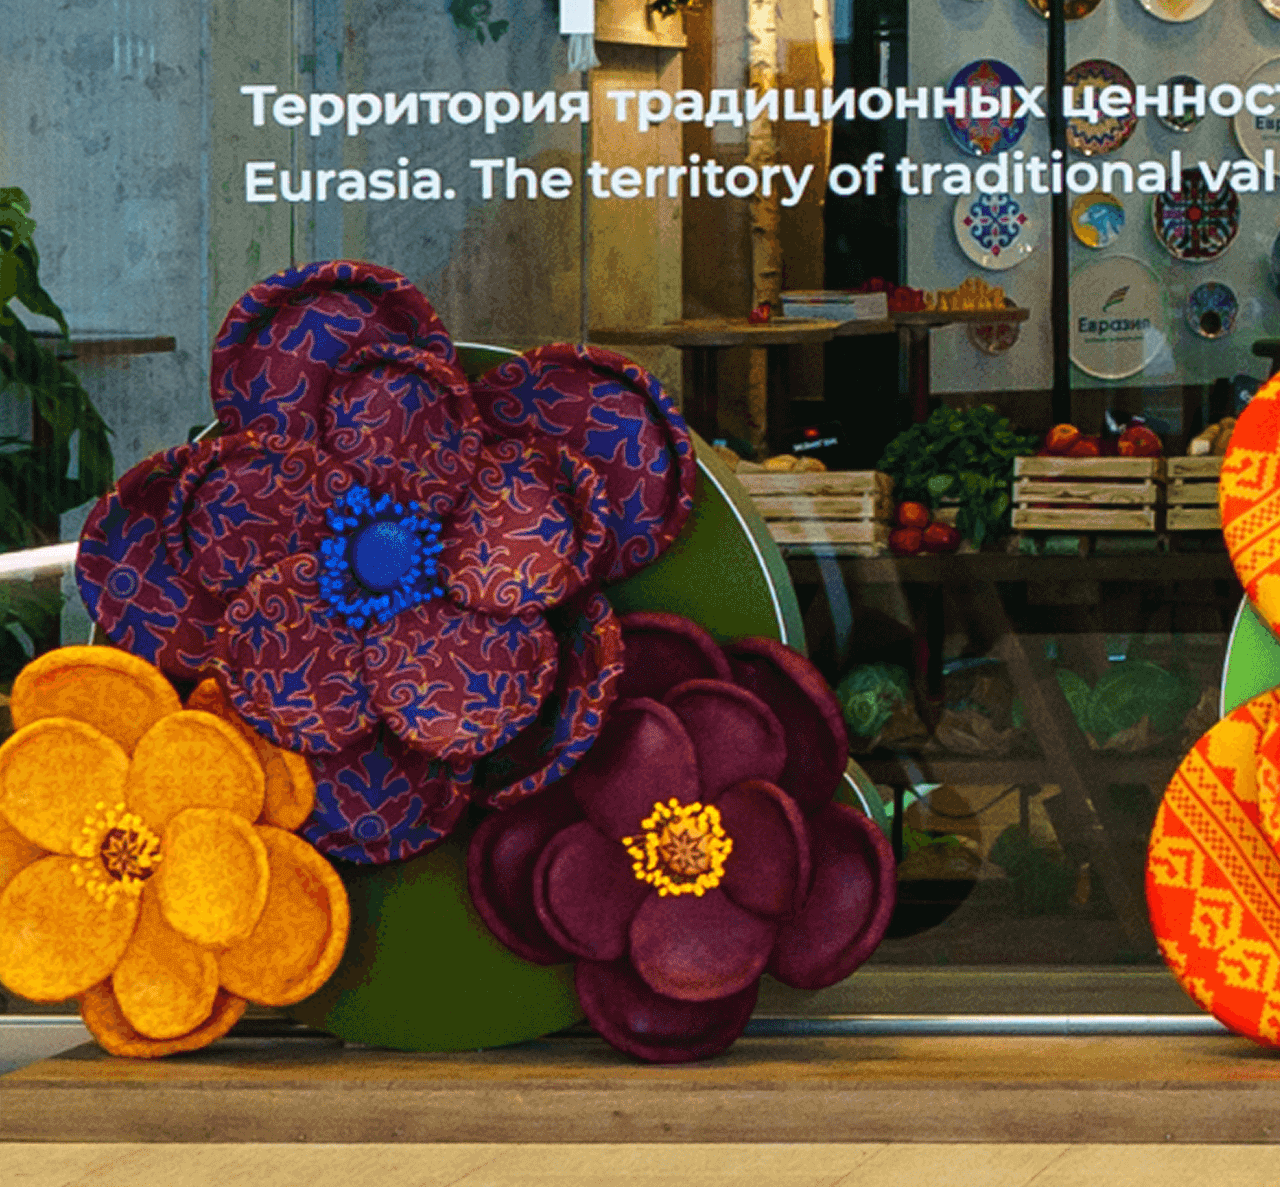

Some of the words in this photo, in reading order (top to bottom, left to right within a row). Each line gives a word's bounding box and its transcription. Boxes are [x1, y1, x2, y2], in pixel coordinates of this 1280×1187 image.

[240, 84, 591, 136] Территория
[606, 83, 1046, 132] традиционных
[245, 157, 456, 203] Eurasia.
[469, 157, 573, 201] The
[587, 153, 814, 207] territory
[829, 152, 885, 197] of
[896, 148, 1182, 197] traditional
